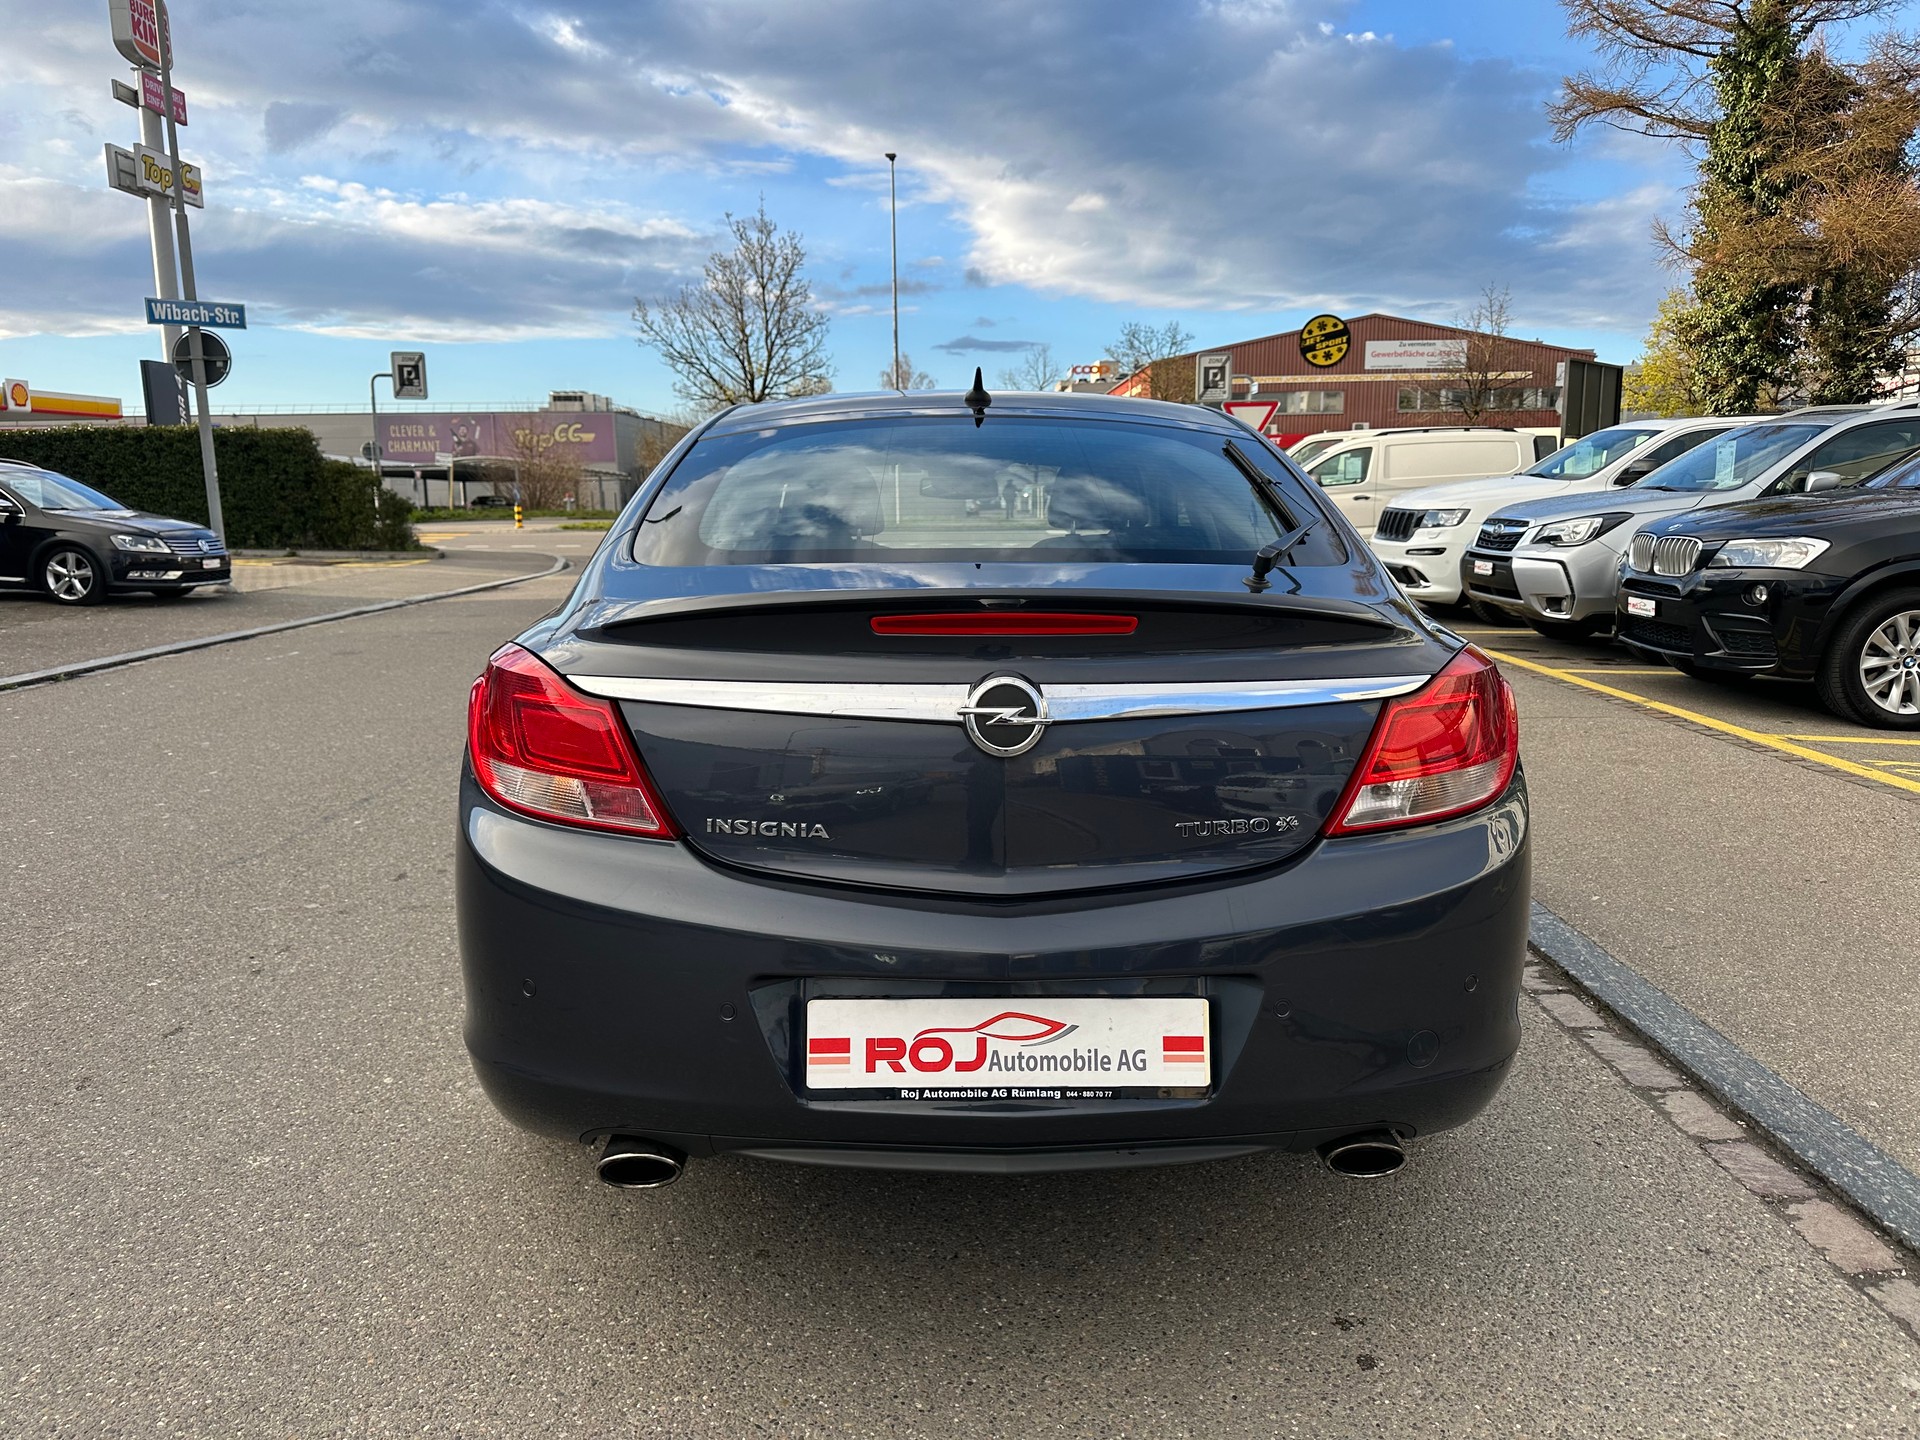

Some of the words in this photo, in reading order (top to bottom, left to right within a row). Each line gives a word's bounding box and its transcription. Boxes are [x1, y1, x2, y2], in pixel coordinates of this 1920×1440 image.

[141, 154, 192, 193] TopC
[151, 302, 240, 324] Wibach-Str.
[1315, 335, 1348, 350] SPORT
[1371, 350, 1425, 358] Gewerbefläche
[390, 424, 425, 437] CLEVER
[428, 424, 437, 437] &
[388, 440, 440, 453] CHARMANT
[706, 818, 830, 839] INSIGNIA
[1175, 817, 1270, 837] TURBO
[865, 1036, 988, 1073] ROJ
[988, 1049, 1111, 1073] Automobile
[1117, 1049, 1147, 1072] AG
[901, 1089, 919, 1100] Roj
[923, 1089, 989, 1098] Automobile
[991, 1088, 1008, 1098] AG
[1011, 1088, 1061, 1099] Rümlang
